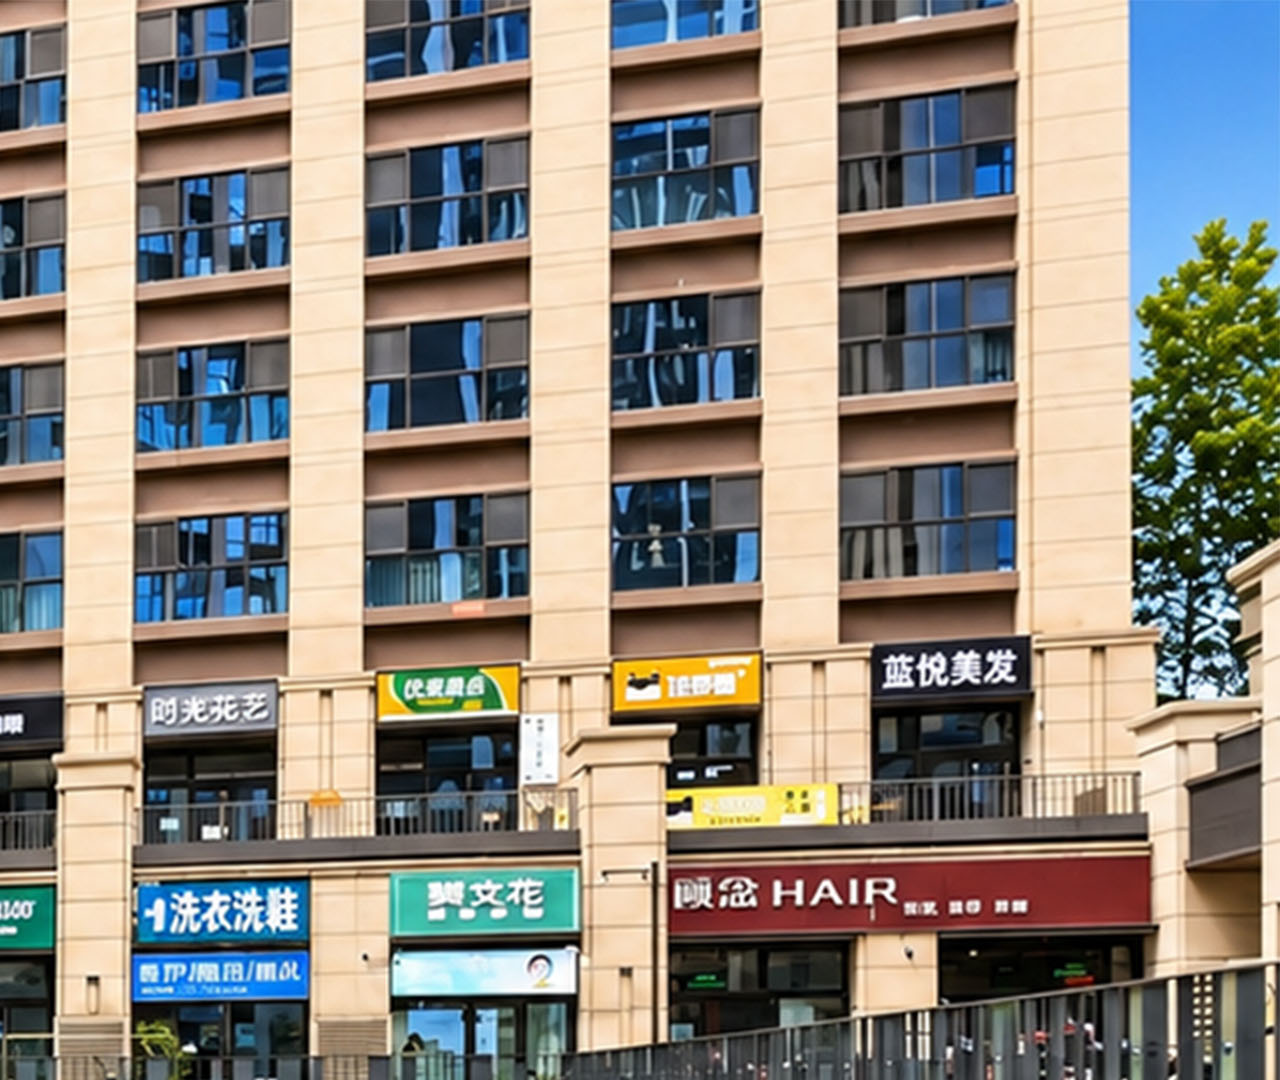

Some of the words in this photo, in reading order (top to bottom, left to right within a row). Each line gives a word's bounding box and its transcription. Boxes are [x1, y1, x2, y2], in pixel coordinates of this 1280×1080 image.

[881, 649, 1018, 690] 蓝悦美发
[169, 886, 300, 934] 洗衣洗鞋
[772, 876, 898, 906] HAIR
